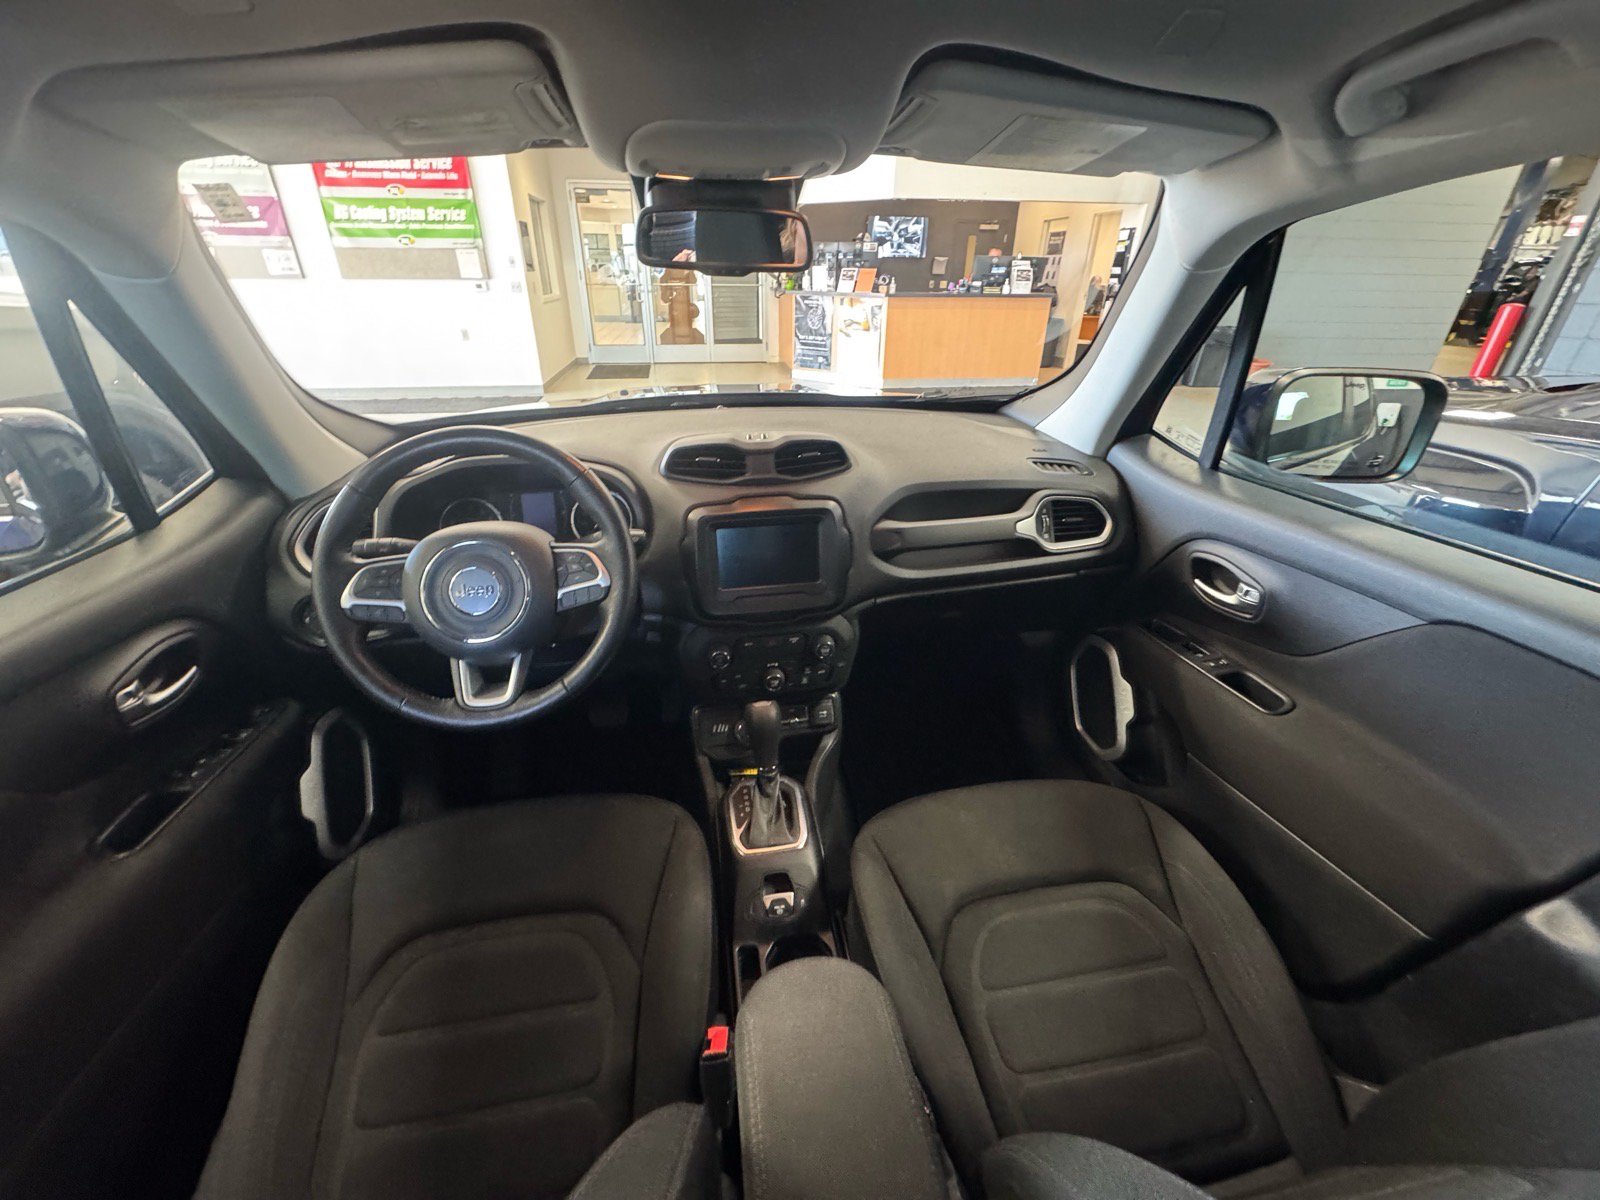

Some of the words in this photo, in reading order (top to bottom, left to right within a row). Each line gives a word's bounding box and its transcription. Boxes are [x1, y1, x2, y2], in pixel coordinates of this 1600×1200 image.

[388, 206, 425, 223] System
[427, 206, 466, 222] Service
[455, 583, 494, 598] Jeep
